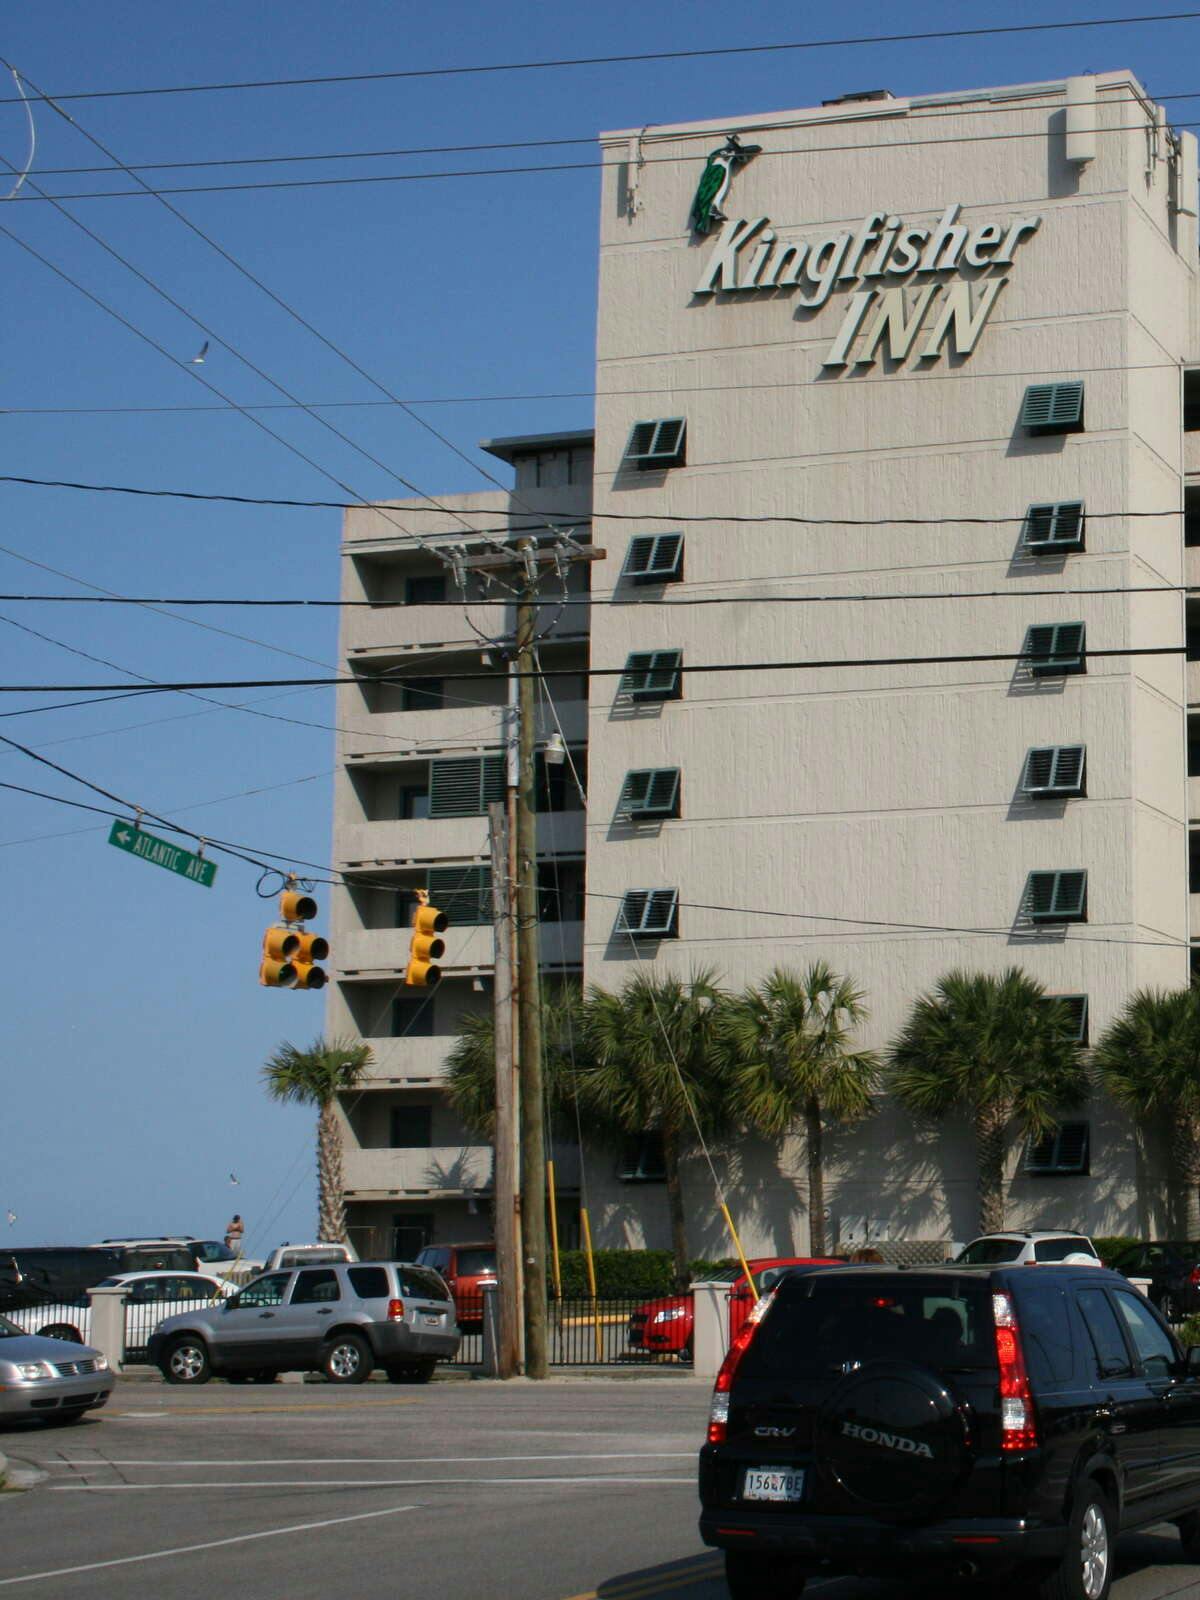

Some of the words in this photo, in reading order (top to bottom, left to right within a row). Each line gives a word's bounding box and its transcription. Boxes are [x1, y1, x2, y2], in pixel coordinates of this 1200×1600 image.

[693, 202, 1042, 309] Kingfisher
[822, 276, 1009, 367] INN
[132, 834, 181, 871] ATLANTIC
[185, 858, 209, 882] AVE
[754, 1426, 797, 1438] CR-V
[840, 1421, 935, 1459] HONDA
